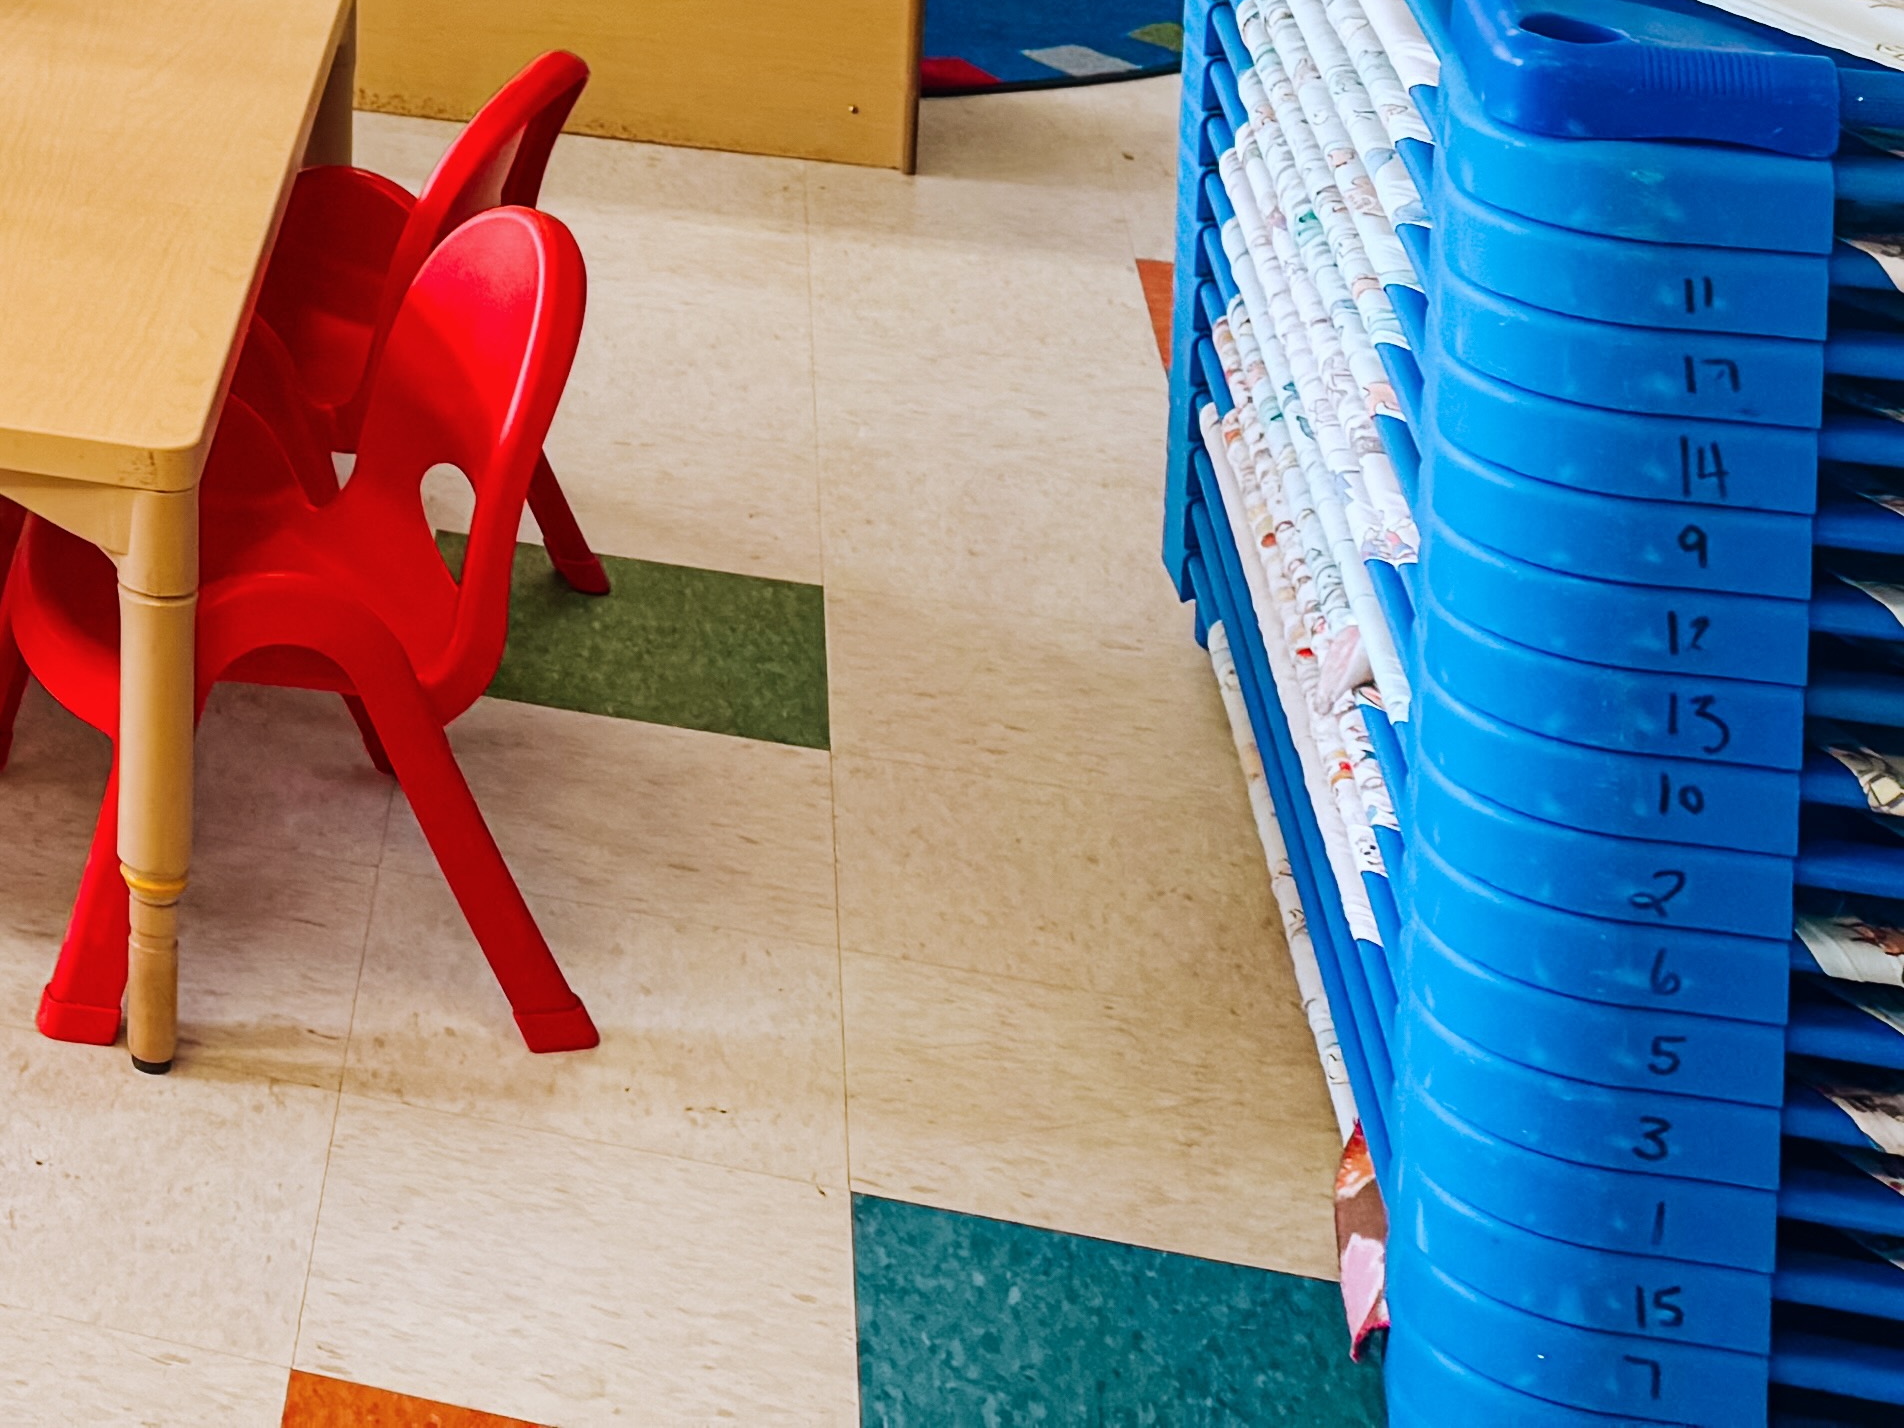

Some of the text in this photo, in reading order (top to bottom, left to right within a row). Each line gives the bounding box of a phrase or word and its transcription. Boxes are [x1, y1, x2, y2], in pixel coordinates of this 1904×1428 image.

[1685, 276, 1713, 314] 11
[1680, 436, 1728, 499] 14
[1677, 524, 1707, 568] 9
[1667, 610, 1710, 655] 12
[1659, 772, 1705, 815] 10
[1628, 869, 1686, 918] 2
[1649, 947, 1681, 995] 6
[1647, 1035, 1687, 1075] 5
[1632, 1115, 1672, 1161] 3
[1651, 1201, 1666, 1244] 1
[1635, 1284, 1685, 1329] 15
[1623, 1355, 1661, 1400] 7
